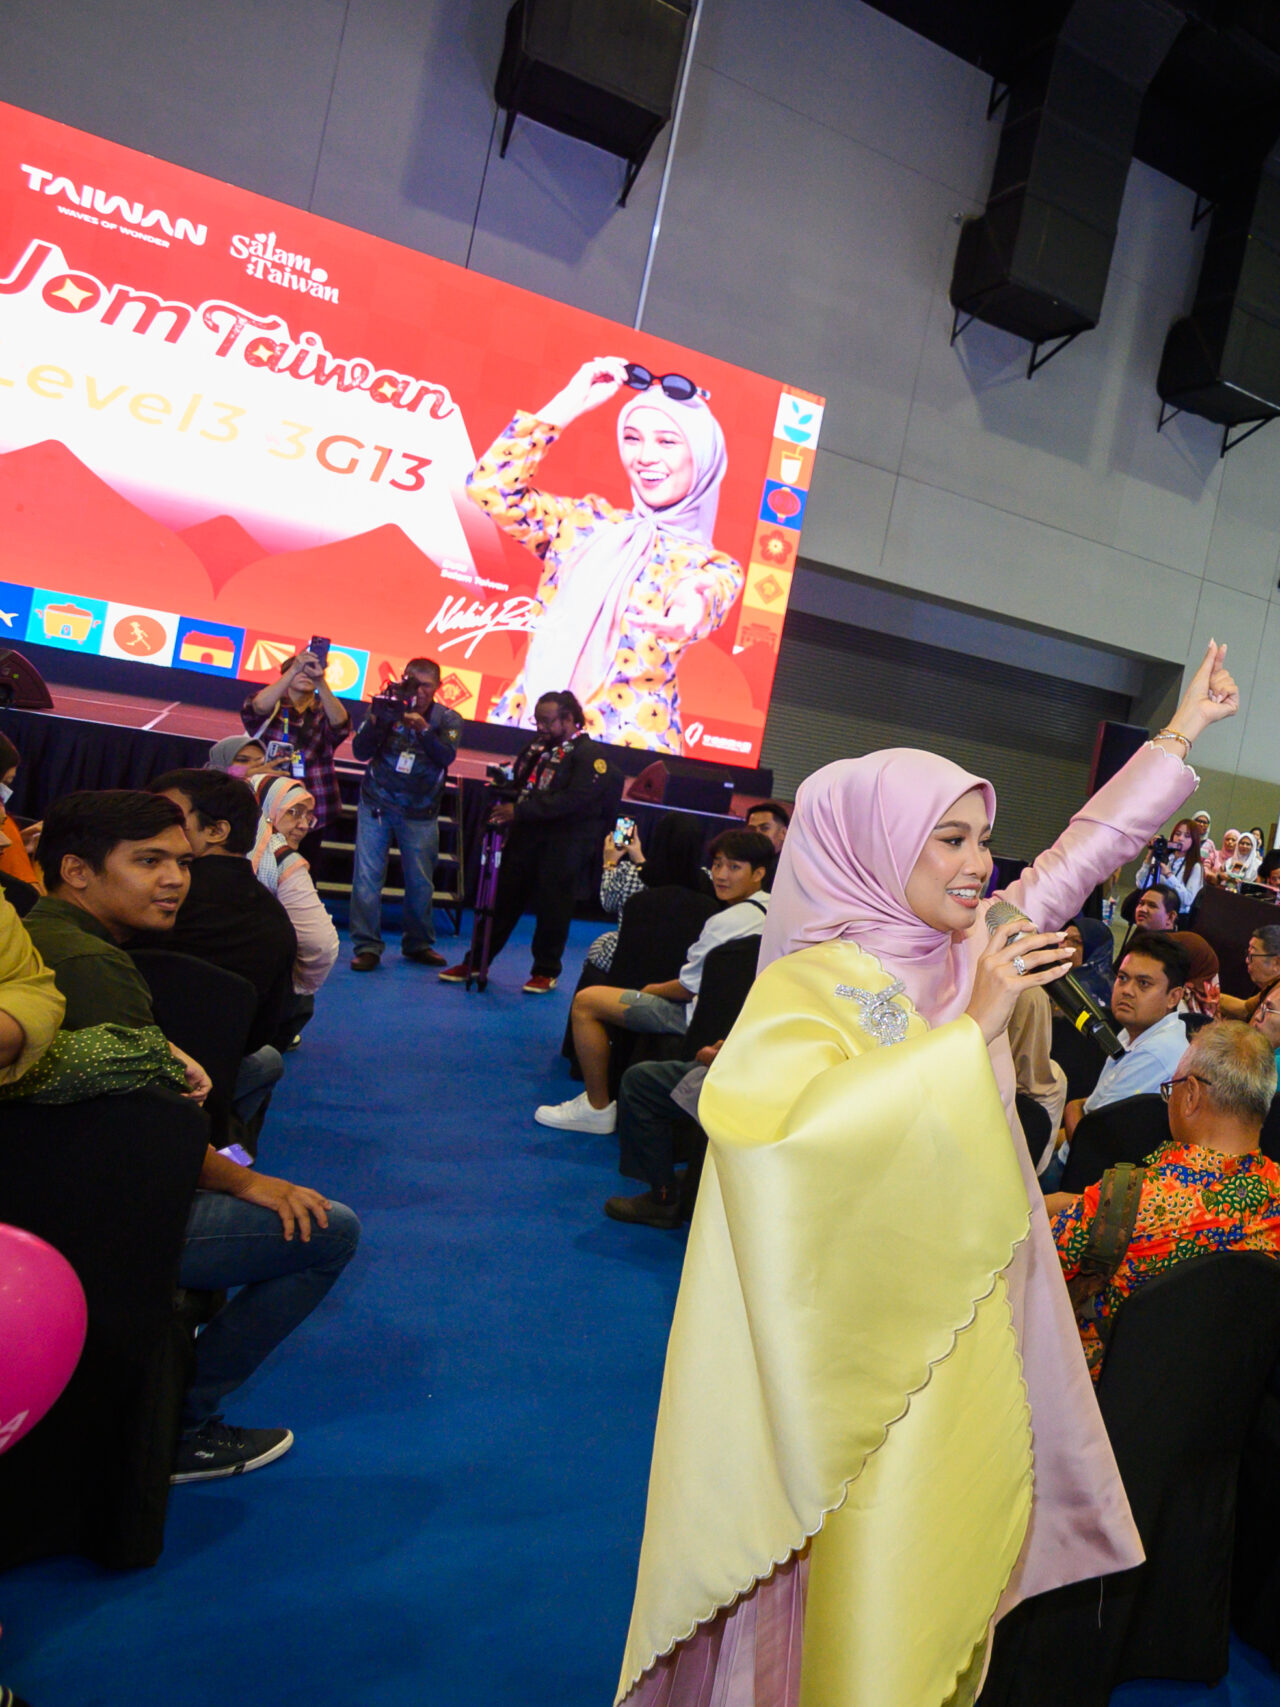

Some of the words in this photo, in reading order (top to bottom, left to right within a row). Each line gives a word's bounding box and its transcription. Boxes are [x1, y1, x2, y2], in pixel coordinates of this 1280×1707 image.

[20, 163, 207, 246] TAIWAN
[57, 204, 100, 225] WAVES
[101, 218, 118, 233] OF
[119, 223, 170, 248] WONDER
[229, 231, 312, 276] Salam
[0, 239, 193, 344] Jom
[202, 303, 455, 420] Taiwan
[268, 419, 433, 492] 3G13
